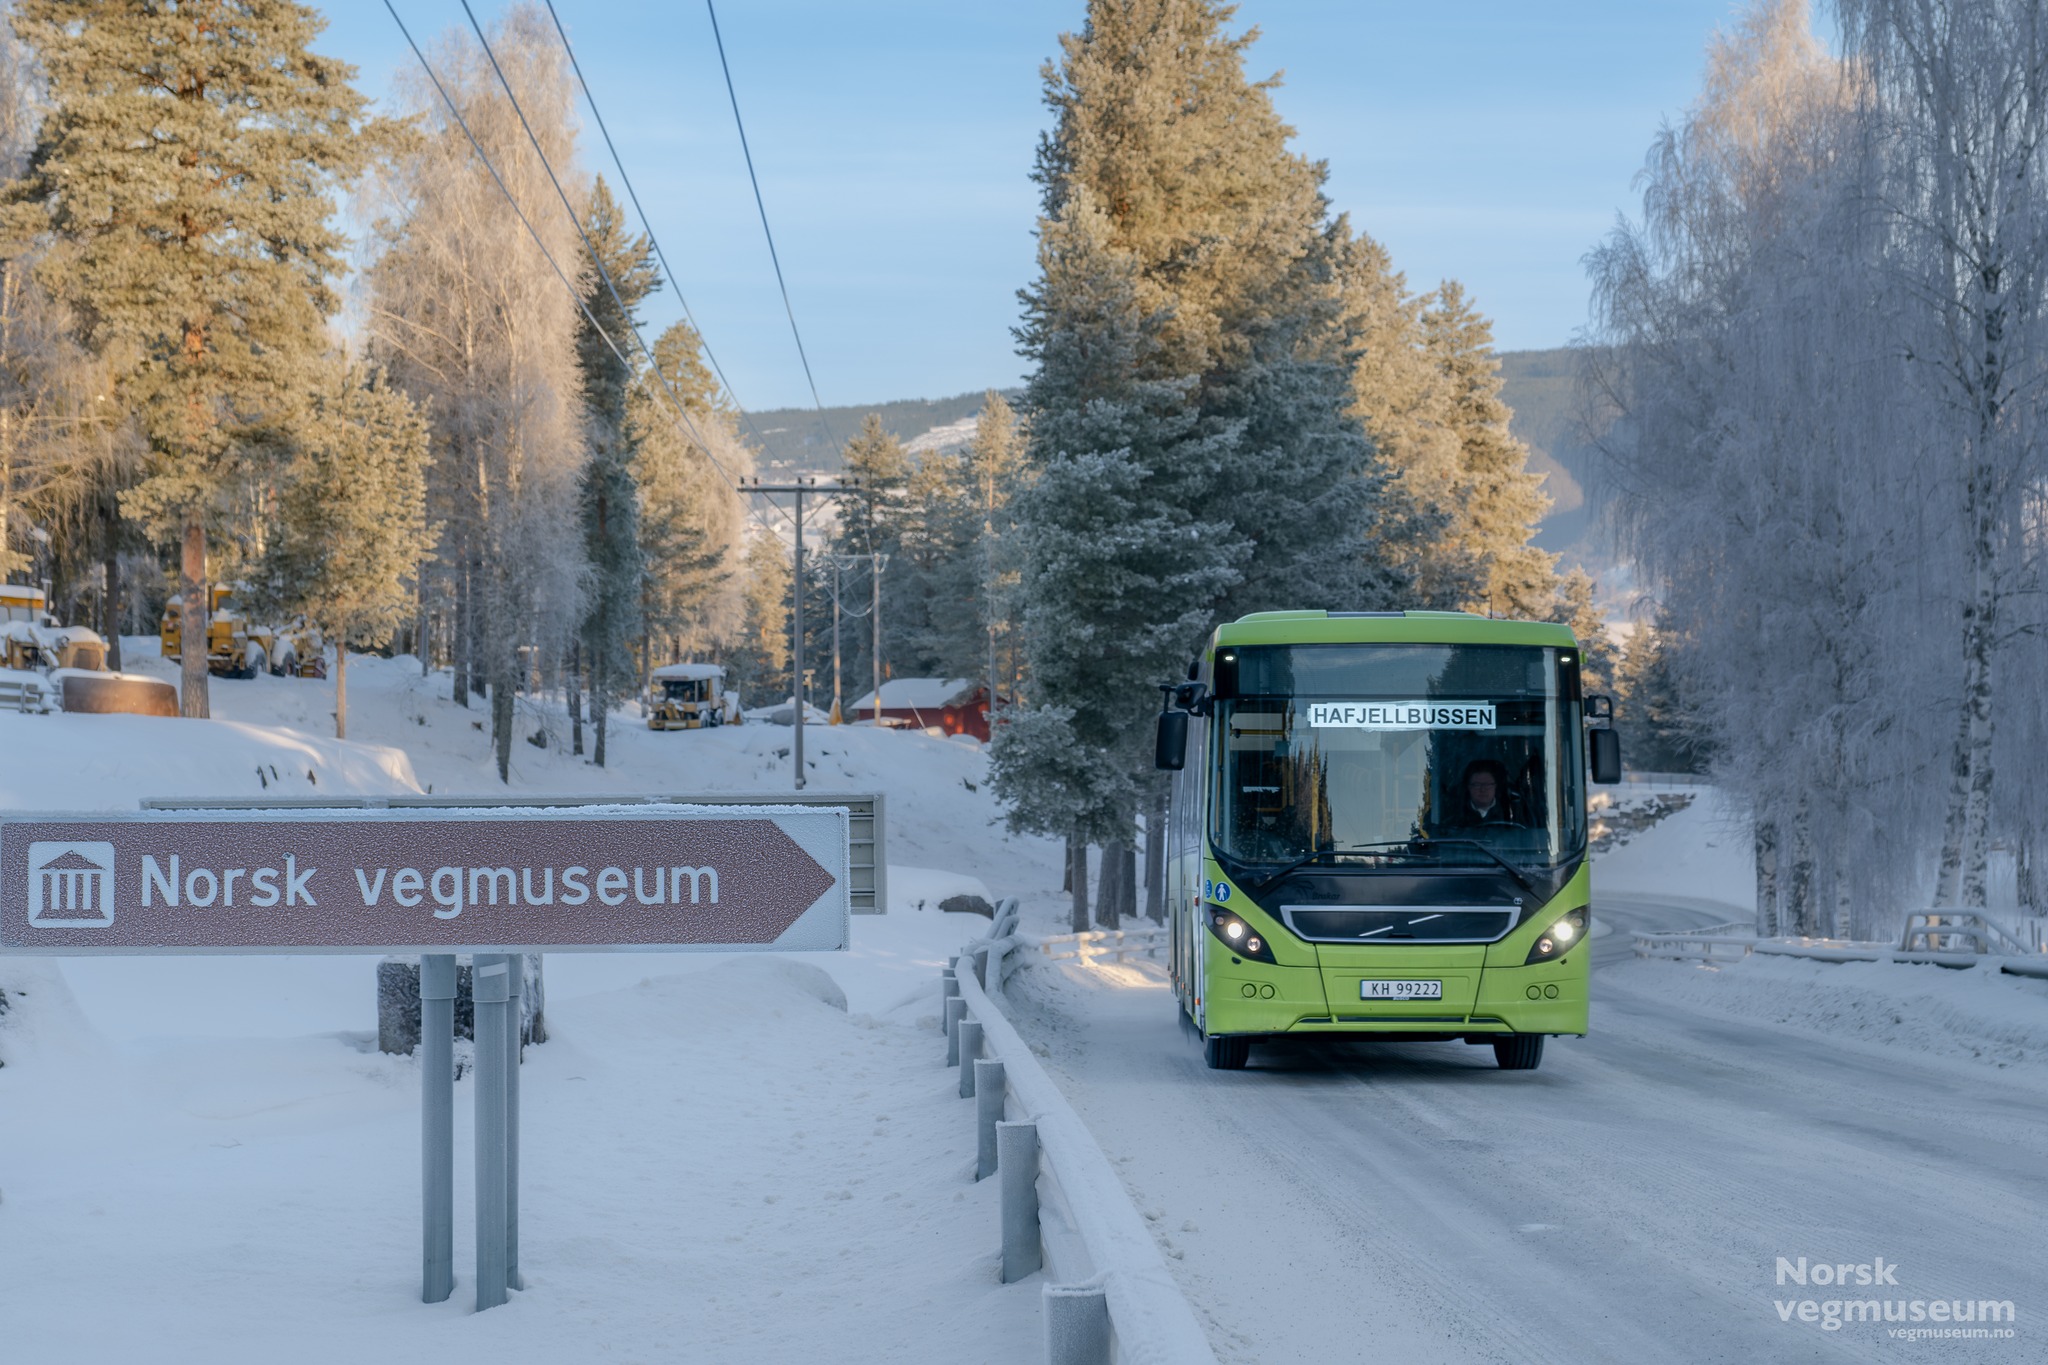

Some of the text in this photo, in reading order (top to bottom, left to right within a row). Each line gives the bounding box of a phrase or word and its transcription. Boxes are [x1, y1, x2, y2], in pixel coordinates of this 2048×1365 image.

[1314, 707, 1492, 725] HAFJELLBUSSEN
[141, 853, 719, 920] Norsk vegmuseum
[1371, 983, 1439, 996] KH 99222
